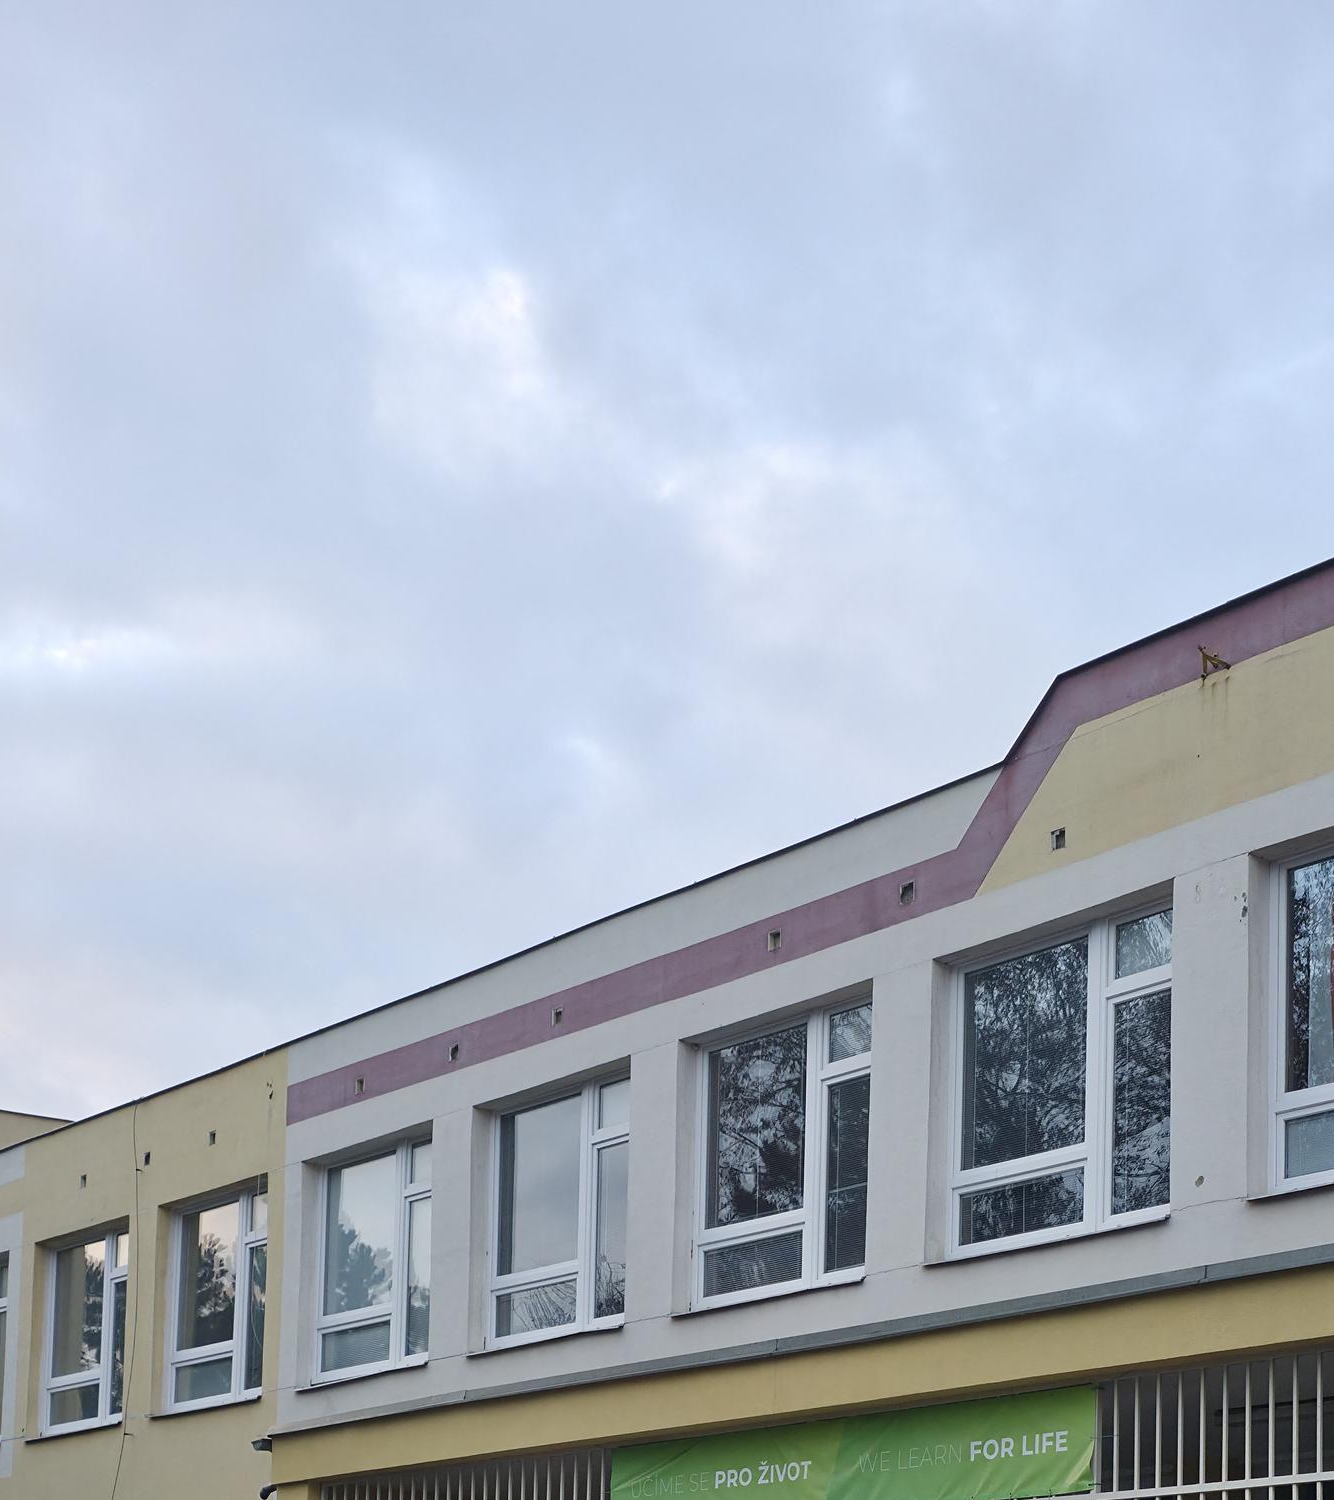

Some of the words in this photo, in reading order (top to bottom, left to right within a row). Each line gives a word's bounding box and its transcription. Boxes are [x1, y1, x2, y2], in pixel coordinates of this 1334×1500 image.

[858, 1450, 892, 1473] WE
[897, 1444, 963, 1470] LEARN
[970, 1437, 1015, 1462] FOR
[1021, 1430, 1068, 1456] LIFE
[631, 1474, 685, 1499] UČÍME
[689, 1471, 710, 1493] SE
[714, 1467, 753, 1489] PRO
[757, 1458, 812, 1485] ŽIVOT
